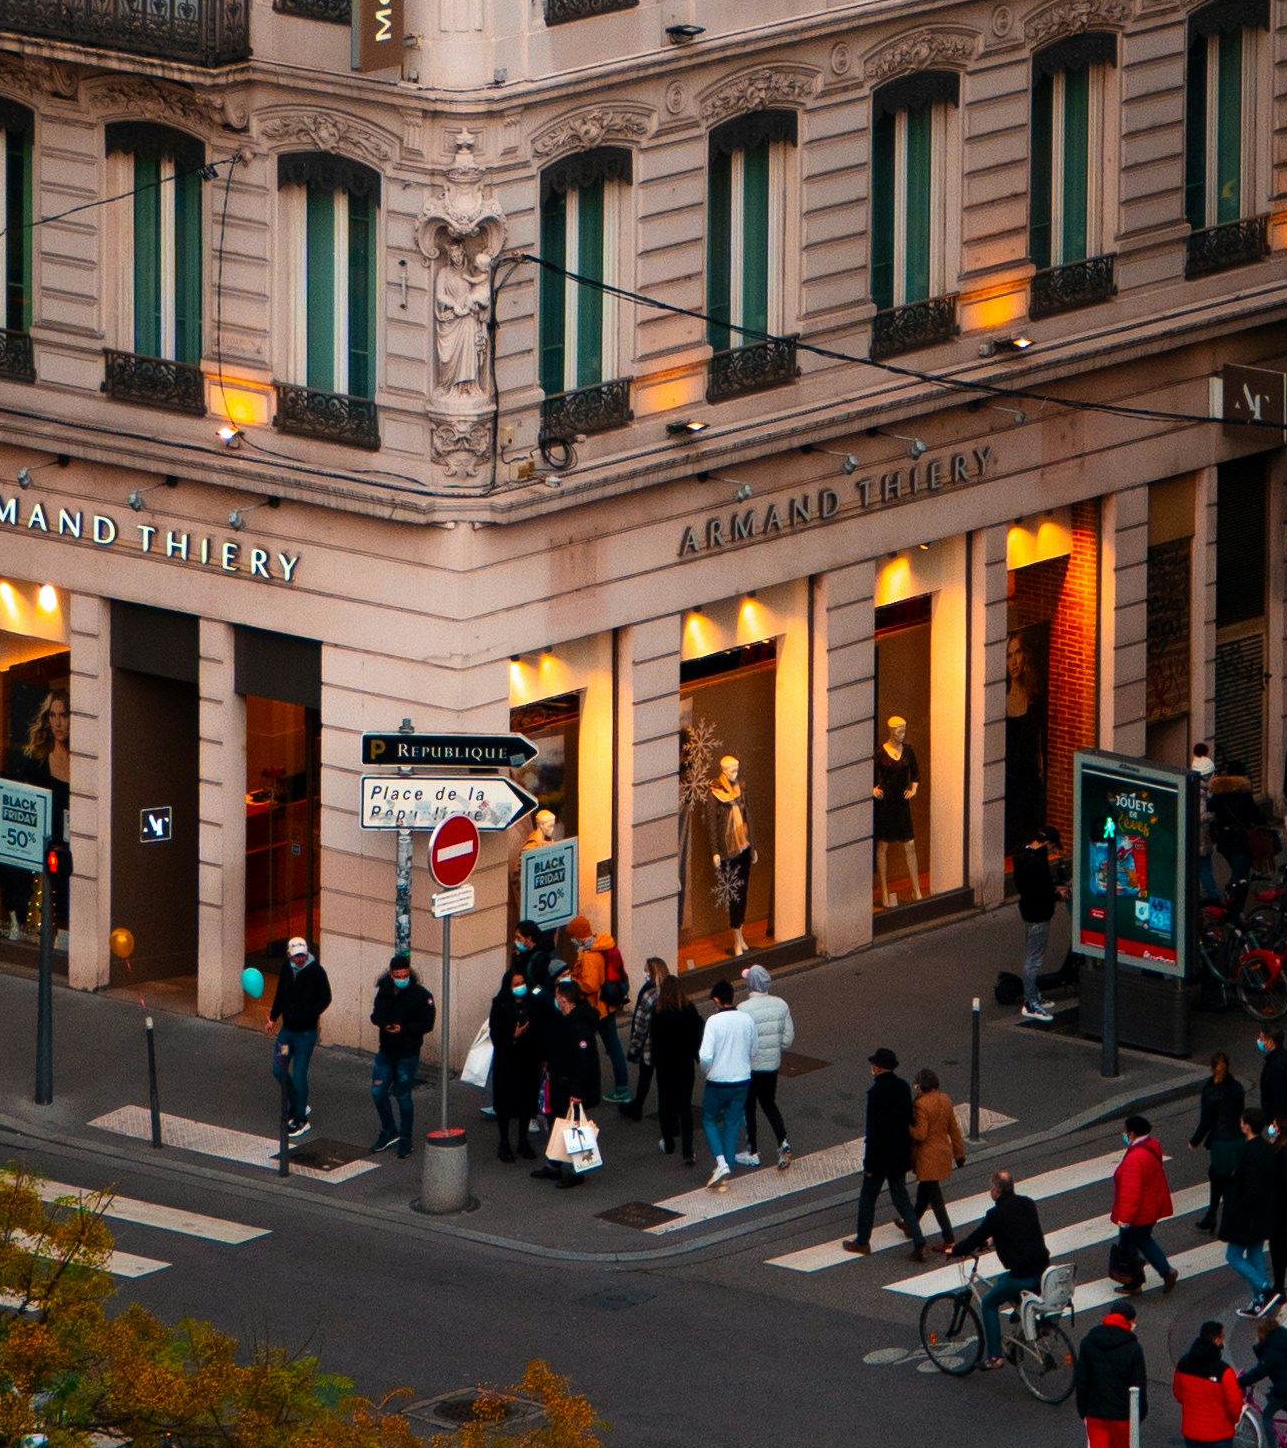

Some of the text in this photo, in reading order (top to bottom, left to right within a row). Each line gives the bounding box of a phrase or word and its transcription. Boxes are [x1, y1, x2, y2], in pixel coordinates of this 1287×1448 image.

[679, 445, 993, 557] ARMAND THIERY
[137, 523, 301, 583] THIERY
[370, 739, 508, 762] P REPUBLIQUE
[370, 785, 485, 801] Place de la
[2, 794, 37, 812] BLACK
[1115, 795, 1155, 814] JOUETS
[3, 809, 37, 825] FRIDAY
[1, 827, 36, 848] -50%
[534, 855, 566, 874] BLACK
[534, 869, 565, 888] FRIDAY
[532, 888, 565, 912] -50%
